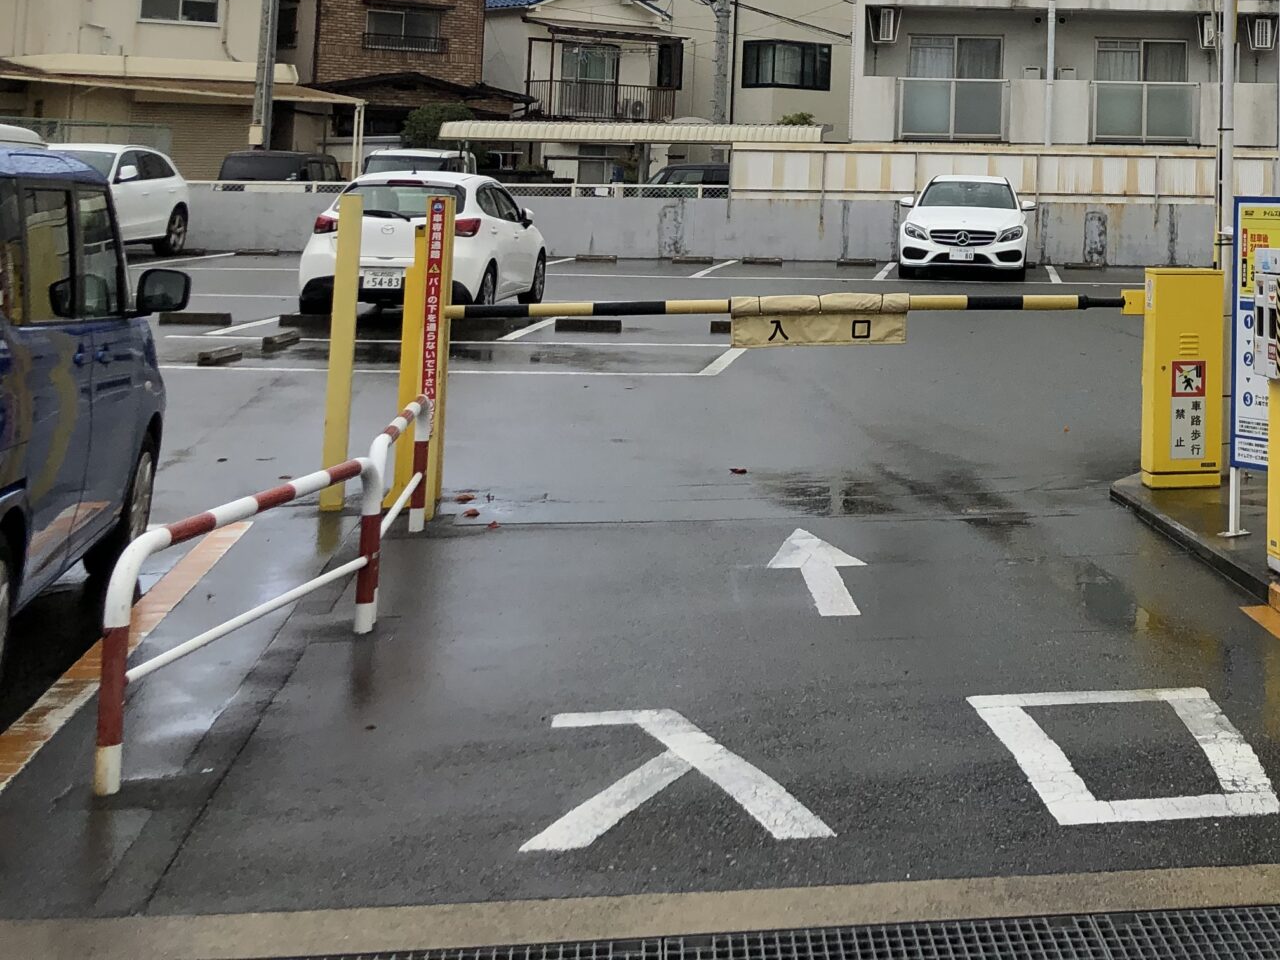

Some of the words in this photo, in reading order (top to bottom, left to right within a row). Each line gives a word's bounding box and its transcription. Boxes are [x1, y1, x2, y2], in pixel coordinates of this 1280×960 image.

[371, 277, 400, 287] 54-83
[424, 277, 439, 395] バーの下を通らないで下さい
[1174, 408, 1186, 448] 禁止
[1190, 400, 1202, 456] 車路歩行
